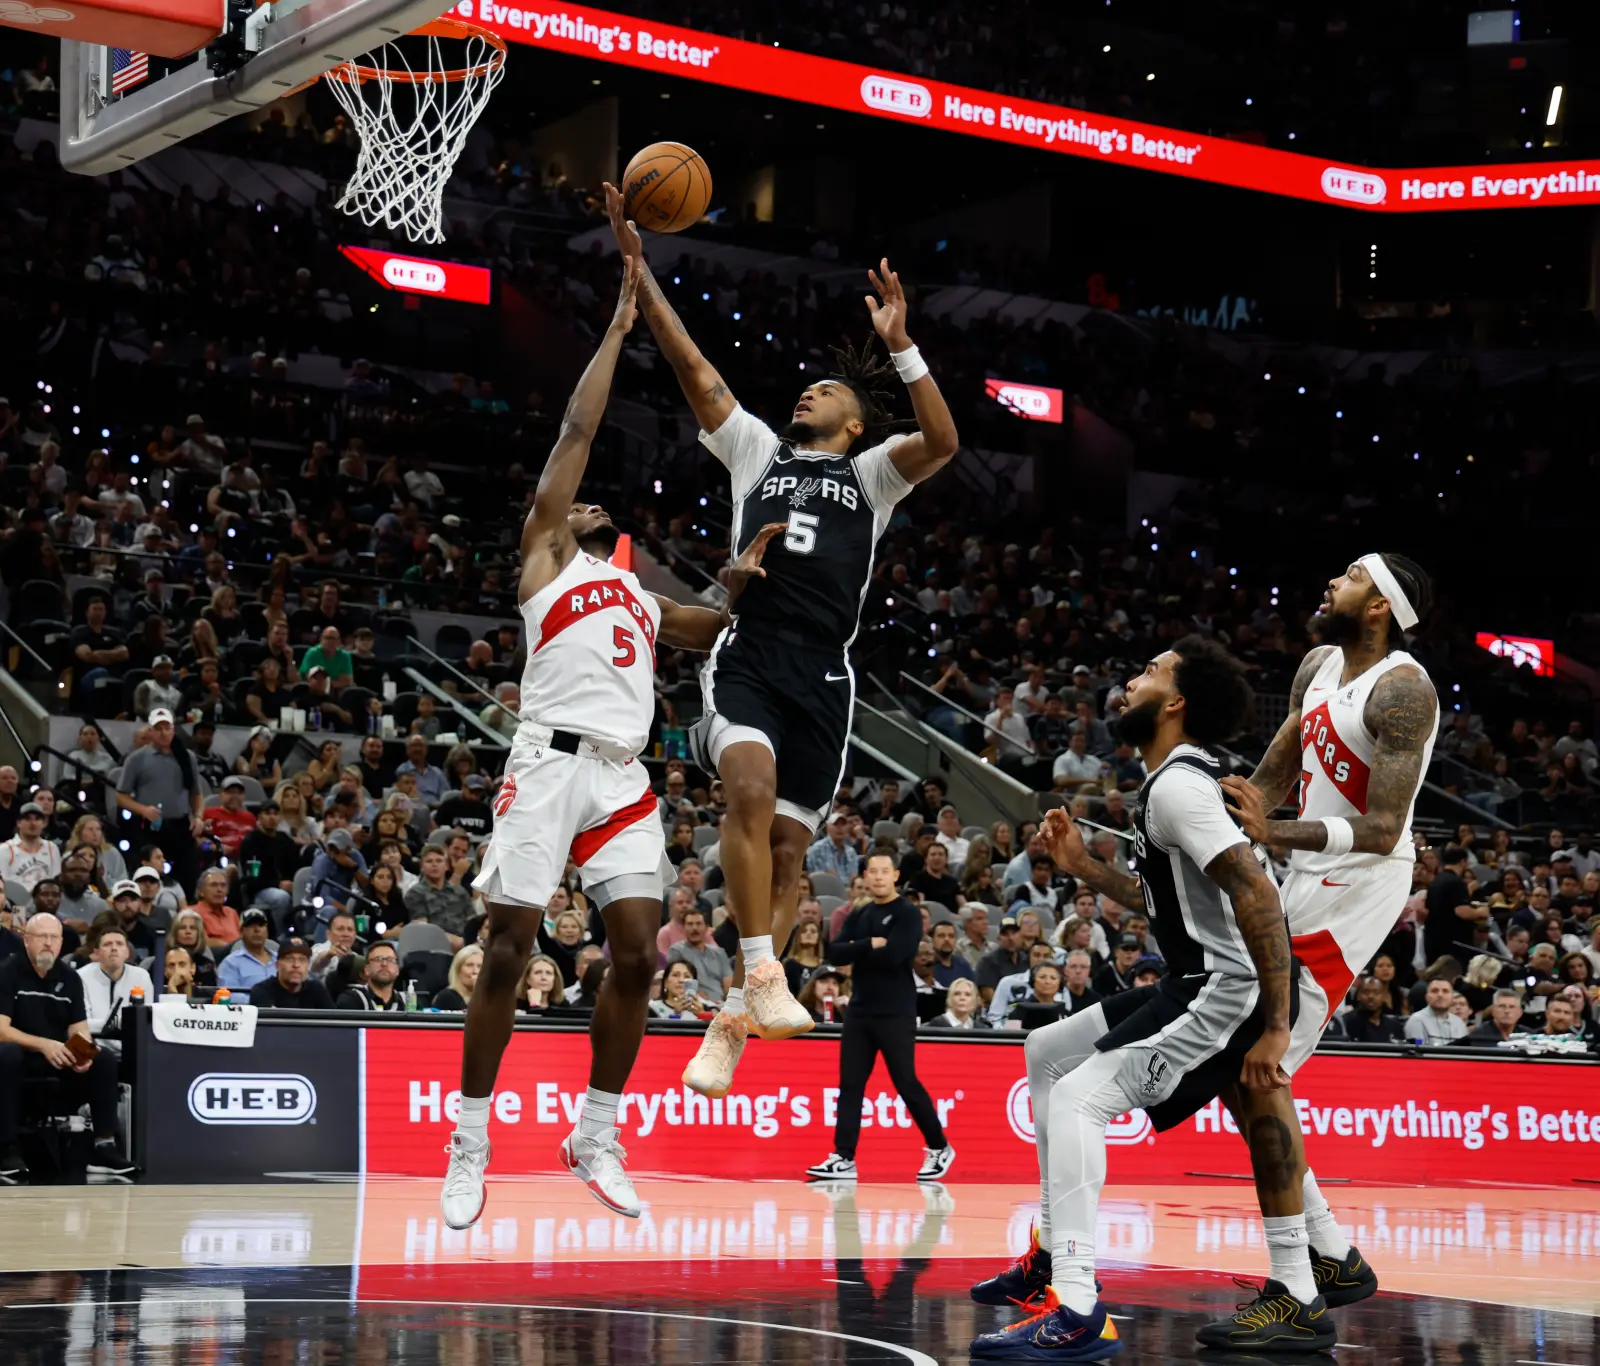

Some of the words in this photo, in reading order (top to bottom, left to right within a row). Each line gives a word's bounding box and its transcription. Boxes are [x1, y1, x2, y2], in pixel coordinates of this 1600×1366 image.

[480, 0, 631, 52] Everything's
[637, 30, 713, 68] Better
[944, 95, 995, 126] Here
[1000, 107, 1127, 154] Everything's
[1131, 132, 1197, 165] Better
[1401, 179, 1465, 200] Here
[1471, 169, 1600, 200] Everythin
[784, 510, 820, 554] 5
[571, 585, 655, 655] RAPTOR
[613, 624, 636, 668] 5
[173, 1018, 239, 1031] GATORADE
[409, 1080, 522, 1124] Hee
[537, 1082, 811, 1138] Evrything's
[1294, 1098, 1509, 1150] Everything's
